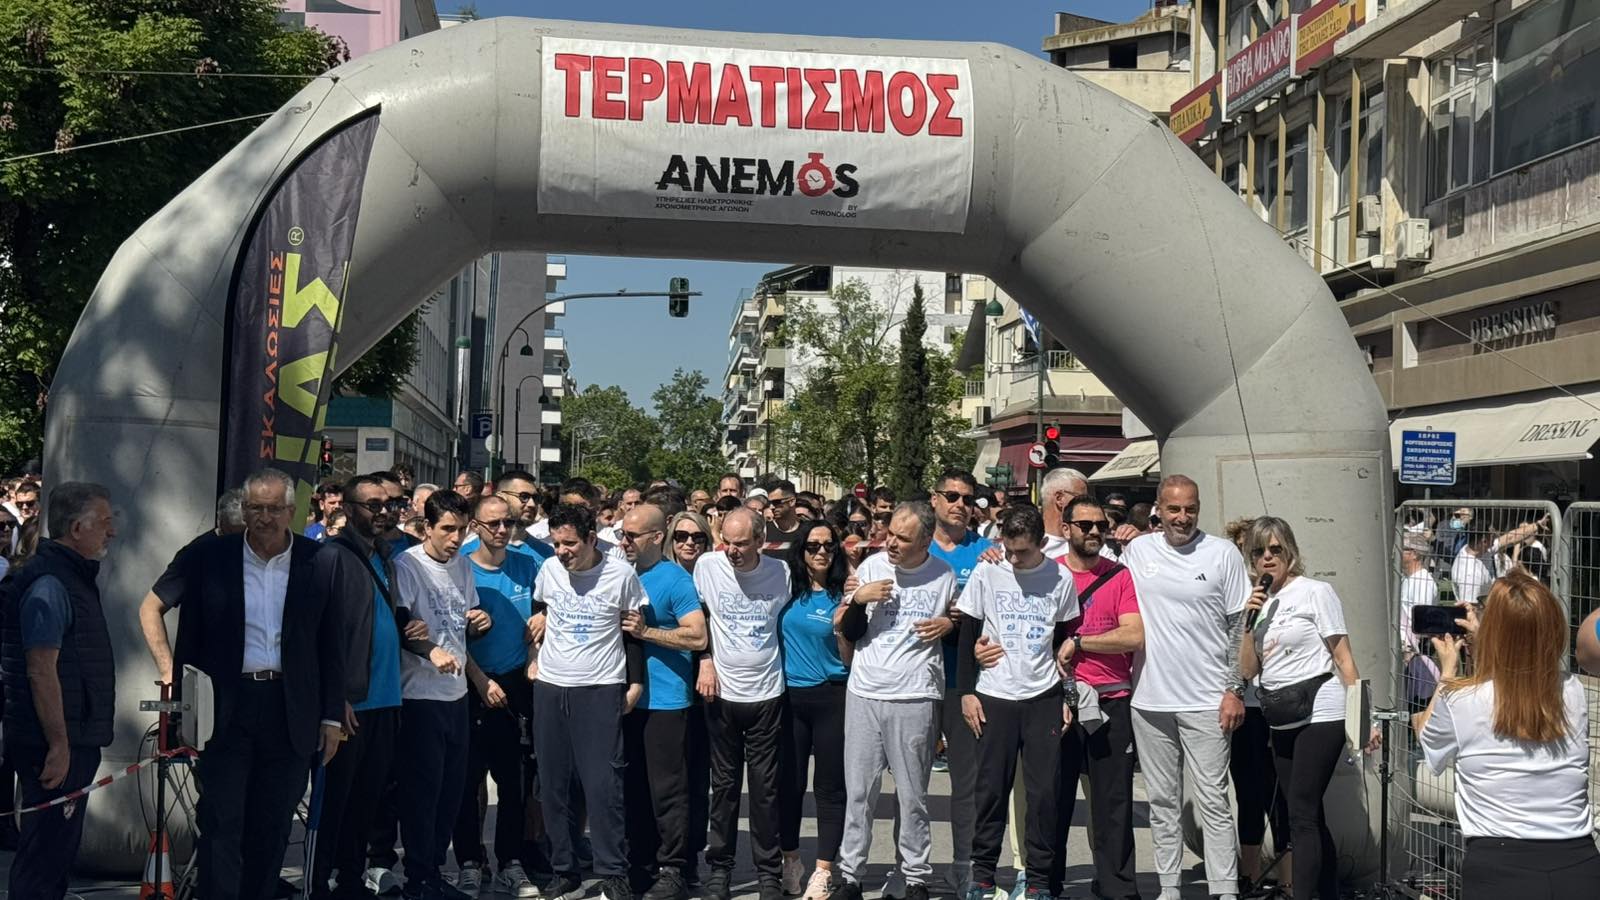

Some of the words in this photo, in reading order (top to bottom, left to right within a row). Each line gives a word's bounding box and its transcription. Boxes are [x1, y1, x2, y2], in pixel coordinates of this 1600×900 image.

[554, 52, 964, 137] ΤΕΡΜΑΤΙΣΜΟΣ
[809, 209, 858, 219] CHRONOLOG
[260, 250, 284, 460] ΣΚΑΛΩΣΙΕΣ
[1518, 418, 1599, 442] DRESSING
[995, 590, 1052, 616] RUN
